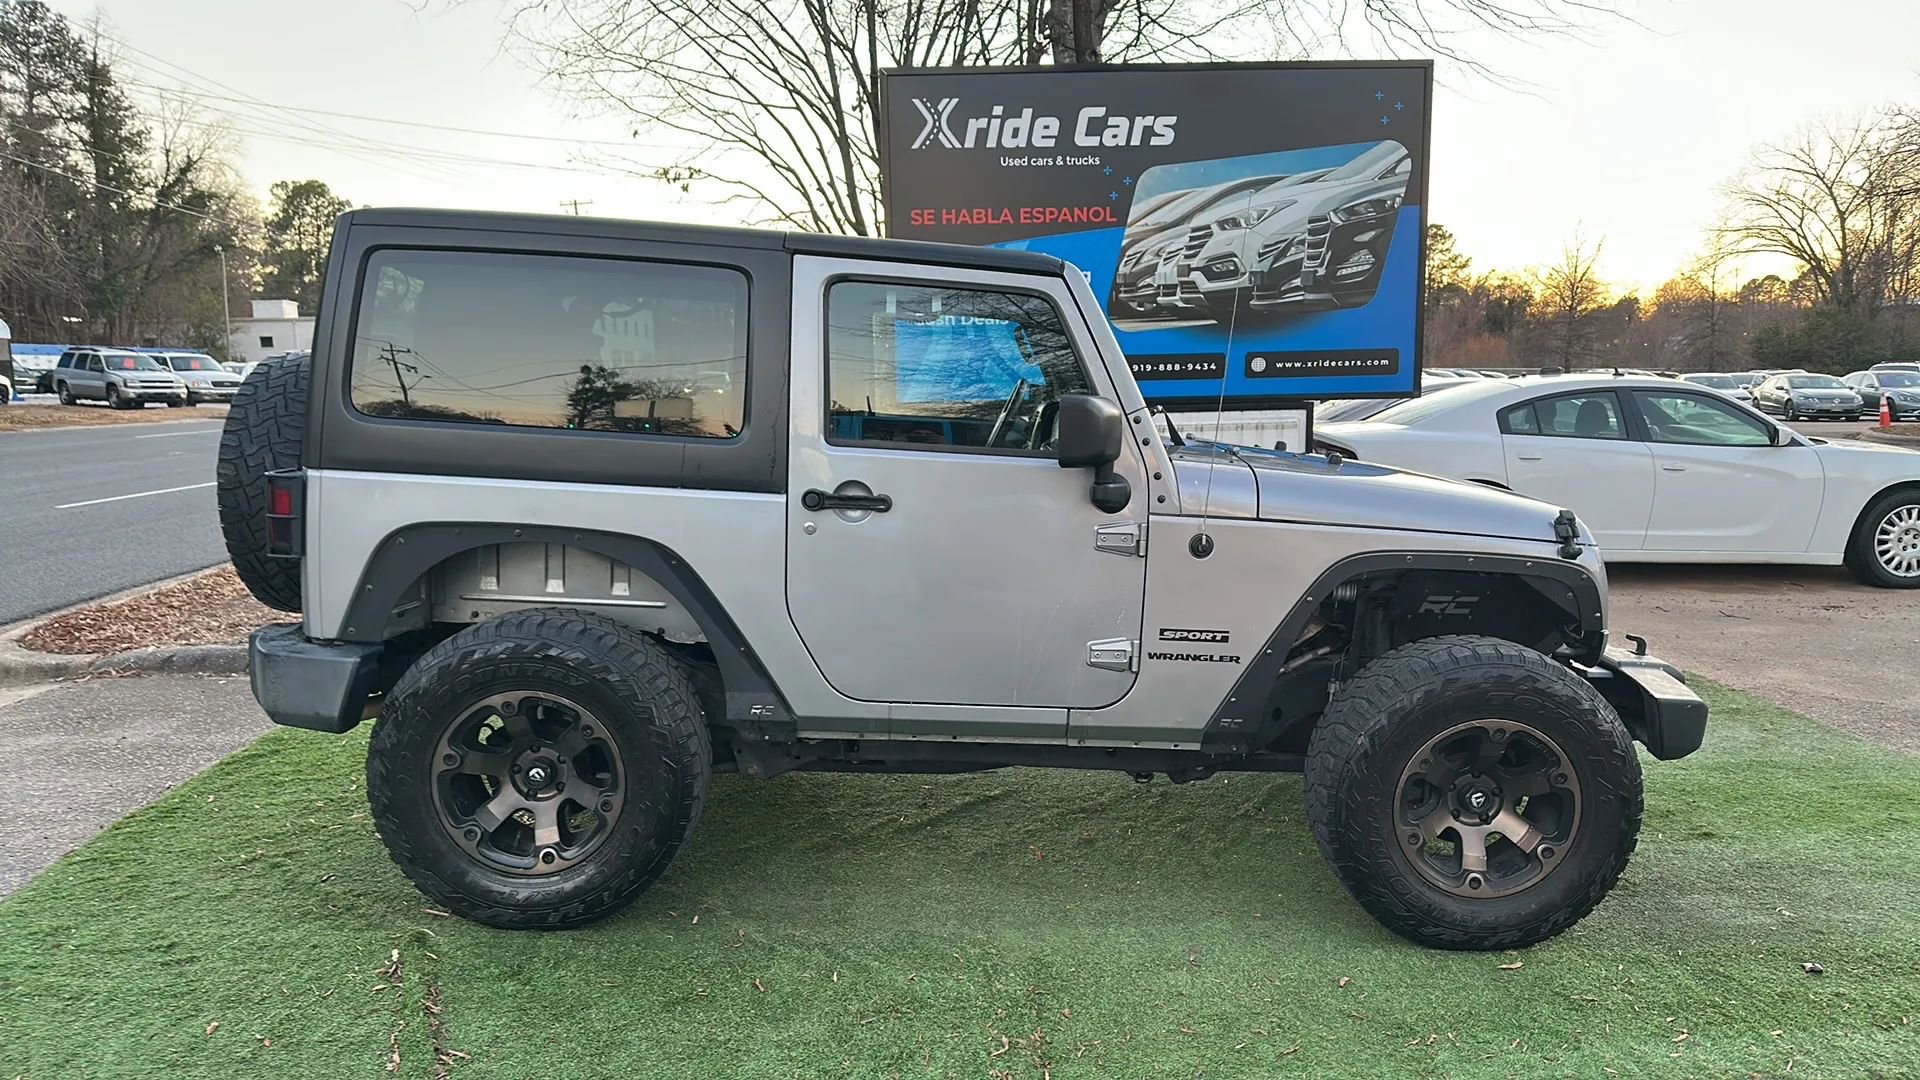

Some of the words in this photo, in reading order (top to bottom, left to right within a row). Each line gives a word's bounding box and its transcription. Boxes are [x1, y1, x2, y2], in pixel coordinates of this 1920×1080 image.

[1074, 106, 1178, 147] Cars
[1000, 155, 1028, 167] Used
[1030, 157, 1054, 166] cars
[1055, 155, 1064, 166] &
[1066, 154, 1101, 166] trucks
[910, 208, 936, 225] SE
[941, 208, 1014, 225] HABLA
[1019, 206, 1118, 224] ESPANOL
[1132, 362, 1217, 372] 919-888-9434
[1275, 358, 1389, 369] www.xridecars.com
[1417, 595, 1480, 614] RC
[1159, 630, 1229, 641] SPORT
[1147, 652, 1241, 664] WRANGLER
